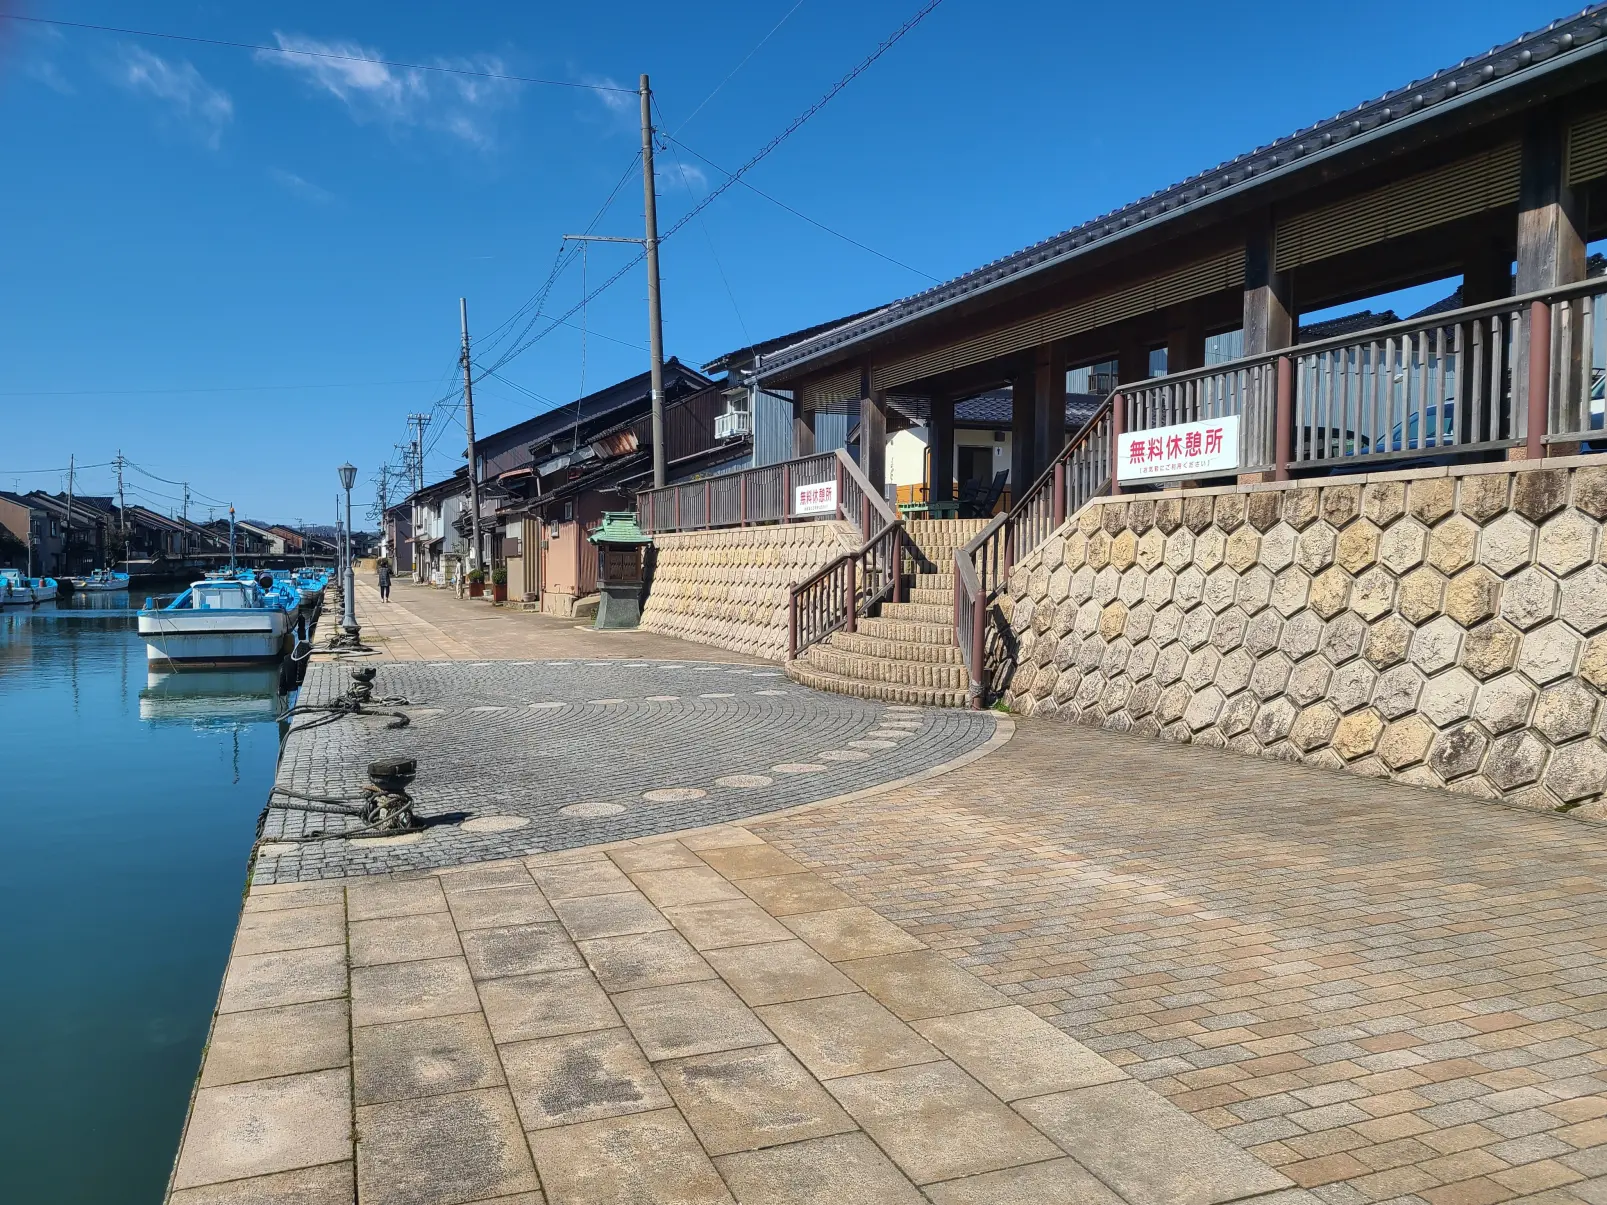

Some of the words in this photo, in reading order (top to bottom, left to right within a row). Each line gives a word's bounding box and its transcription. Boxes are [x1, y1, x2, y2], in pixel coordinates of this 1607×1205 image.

[1130, 428, 1223, 464] 無料休憩所
[800, 487, 832, 505] 無料休憩所
